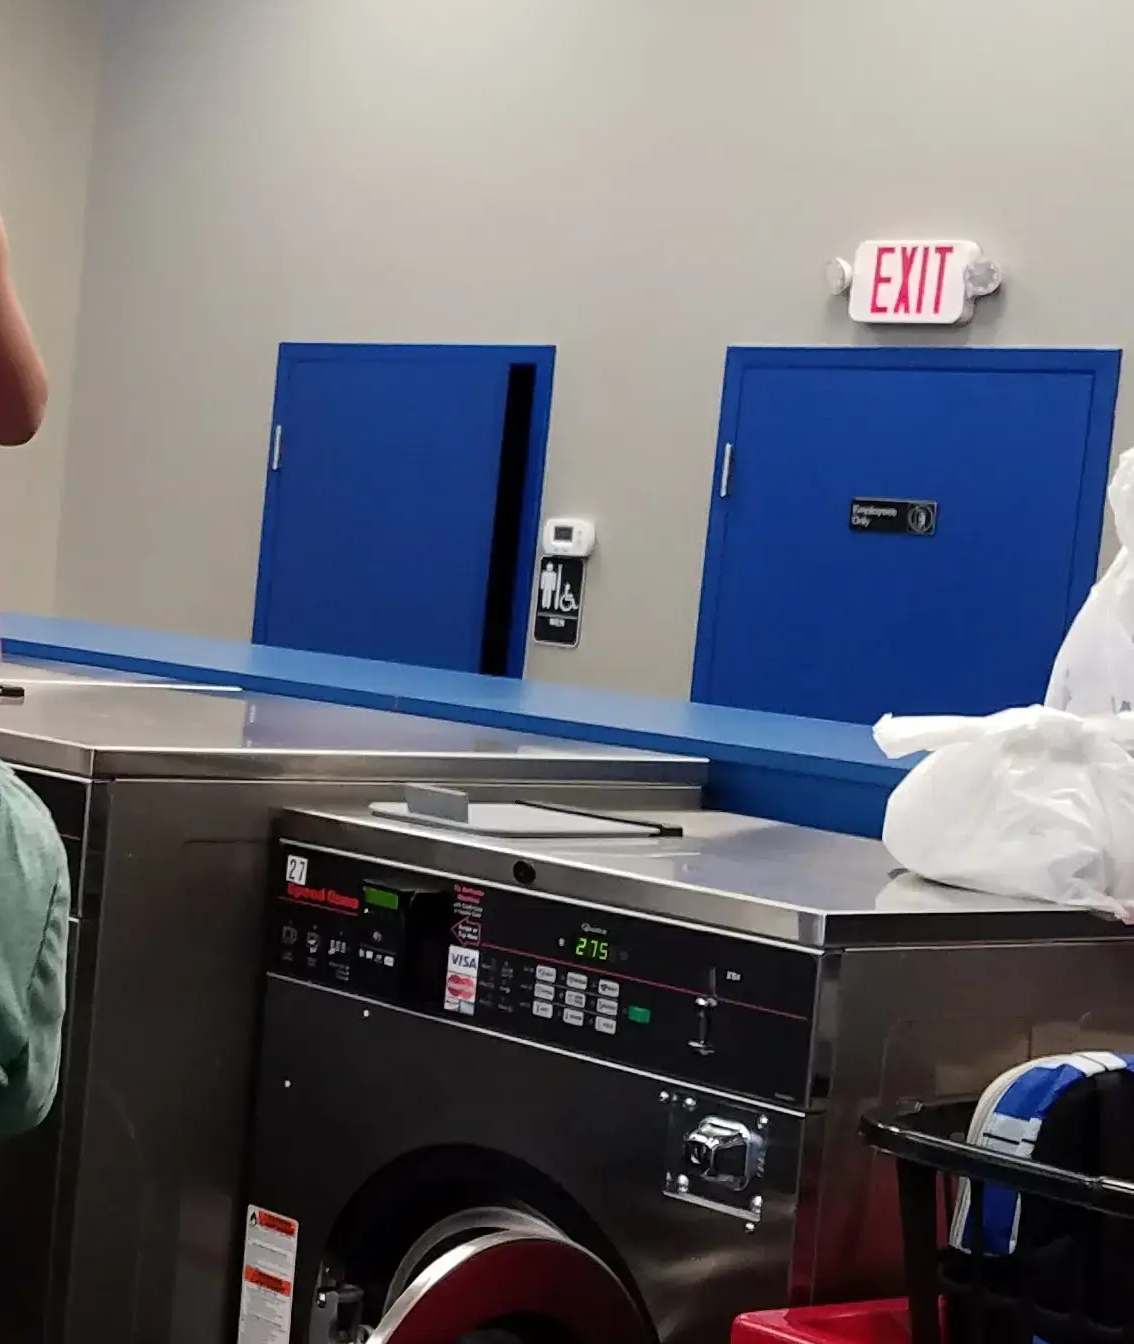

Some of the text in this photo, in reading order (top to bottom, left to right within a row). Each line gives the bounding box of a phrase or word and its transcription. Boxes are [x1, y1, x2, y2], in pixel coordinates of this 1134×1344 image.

[870, 246, 954, 314] EXIT
[288, 859, 305, 881] 27
[575, 937, 608, 960] 275
[451, 953, 477, 969] VISA
